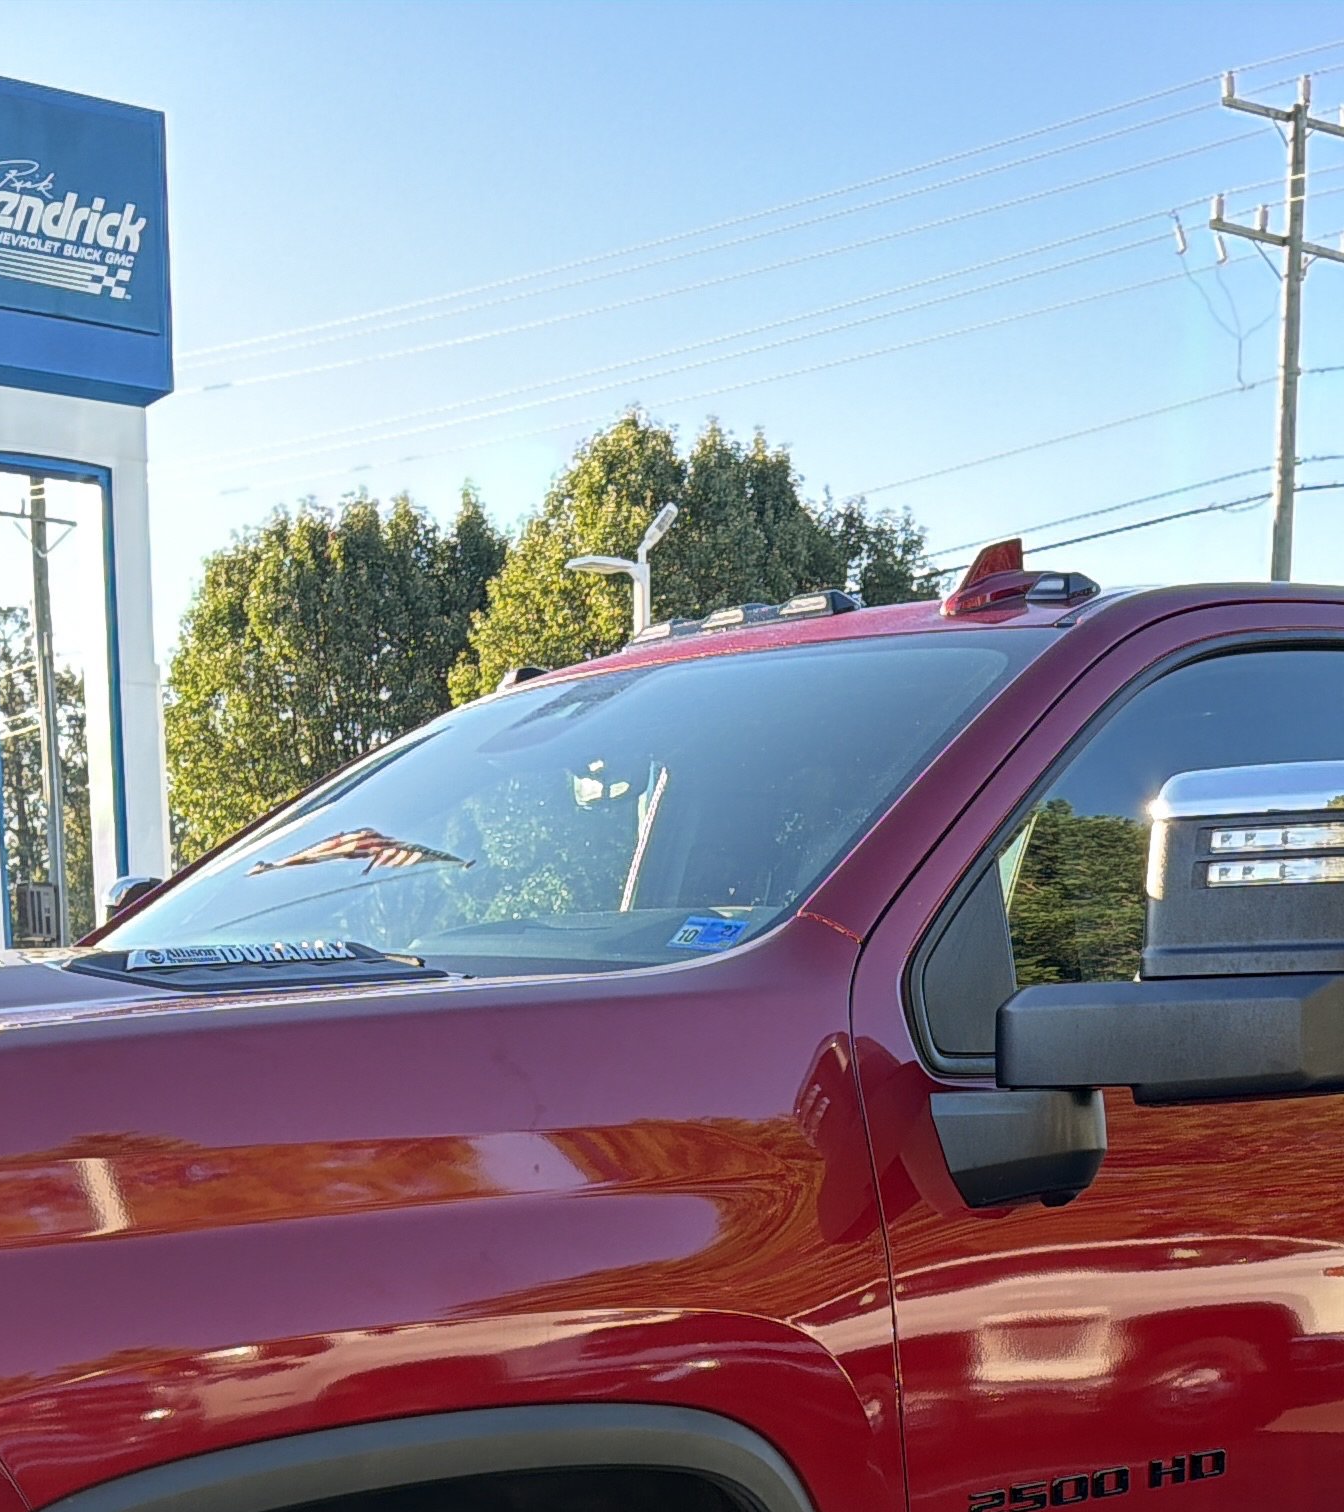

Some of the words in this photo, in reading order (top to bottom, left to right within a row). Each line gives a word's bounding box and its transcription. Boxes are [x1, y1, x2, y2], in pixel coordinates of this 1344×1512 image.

[63, 245, 103, 262] BUICK
[105, 251, 135, 268] GMC
[677, 928, 699, 943] 10
[166, 948, 218, 959] Allison
[219, 943, 355, 963] DURAMAX
[1148, 1449, 1227, 1488] HD
